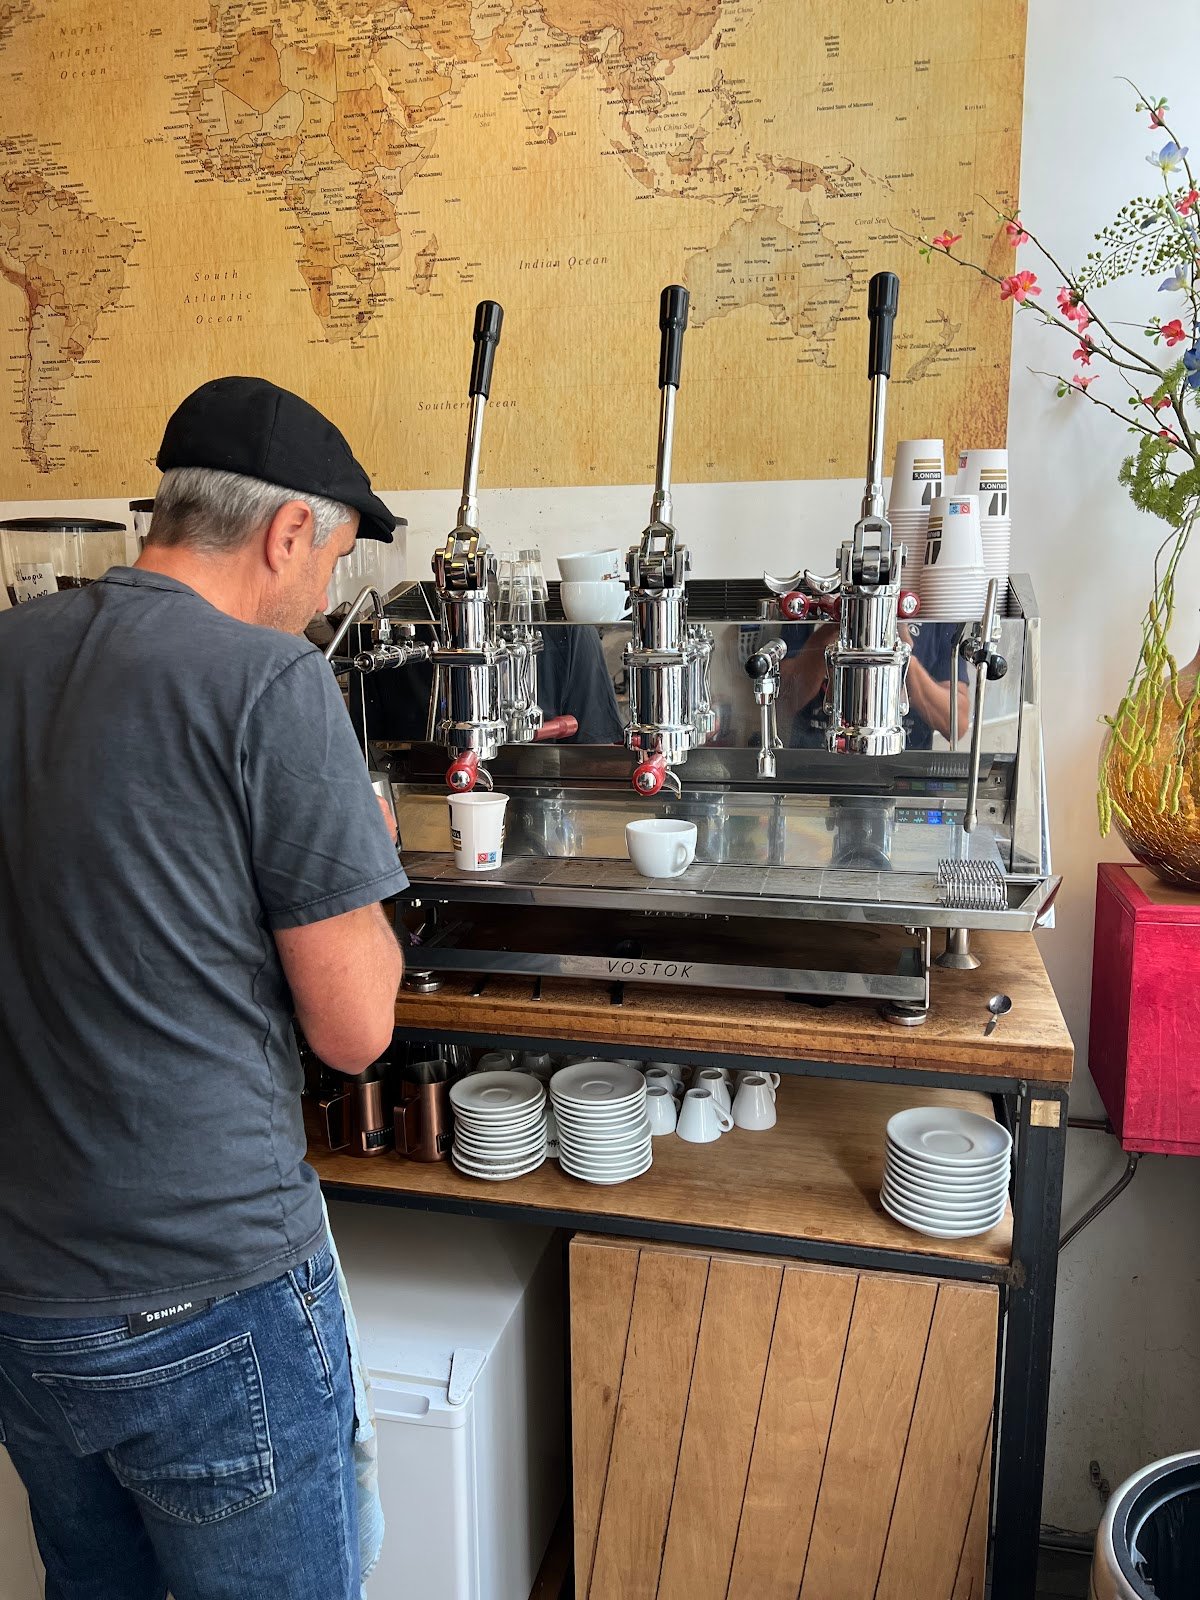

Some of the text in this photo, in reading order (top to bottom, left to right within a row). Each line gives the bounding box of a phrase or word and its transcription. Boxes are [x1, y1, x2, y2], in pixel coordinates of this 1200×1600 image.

[60, 22, 102, 36] North
[60, 67, 106, 80] Ocean
[524, 72, 558, 81] India
[642, 141, 682, 149] Malaysia
[644, 150, 666, 158] Singapore
[62, 246, 96, 255] Brazil
[519, 256, 608, 270] Indian Ocean
[194, 269, 238, 281] South
[730, 274, 795, 284] Australia
[184, 291, 252, 303] Atlantic
[196, 315, 242, 324] Ocean
[485, 399, 517, 408] cean
[608, 960, 694, 978] VOSTOK
[146, 1302, 192, 1322] DENHAM
